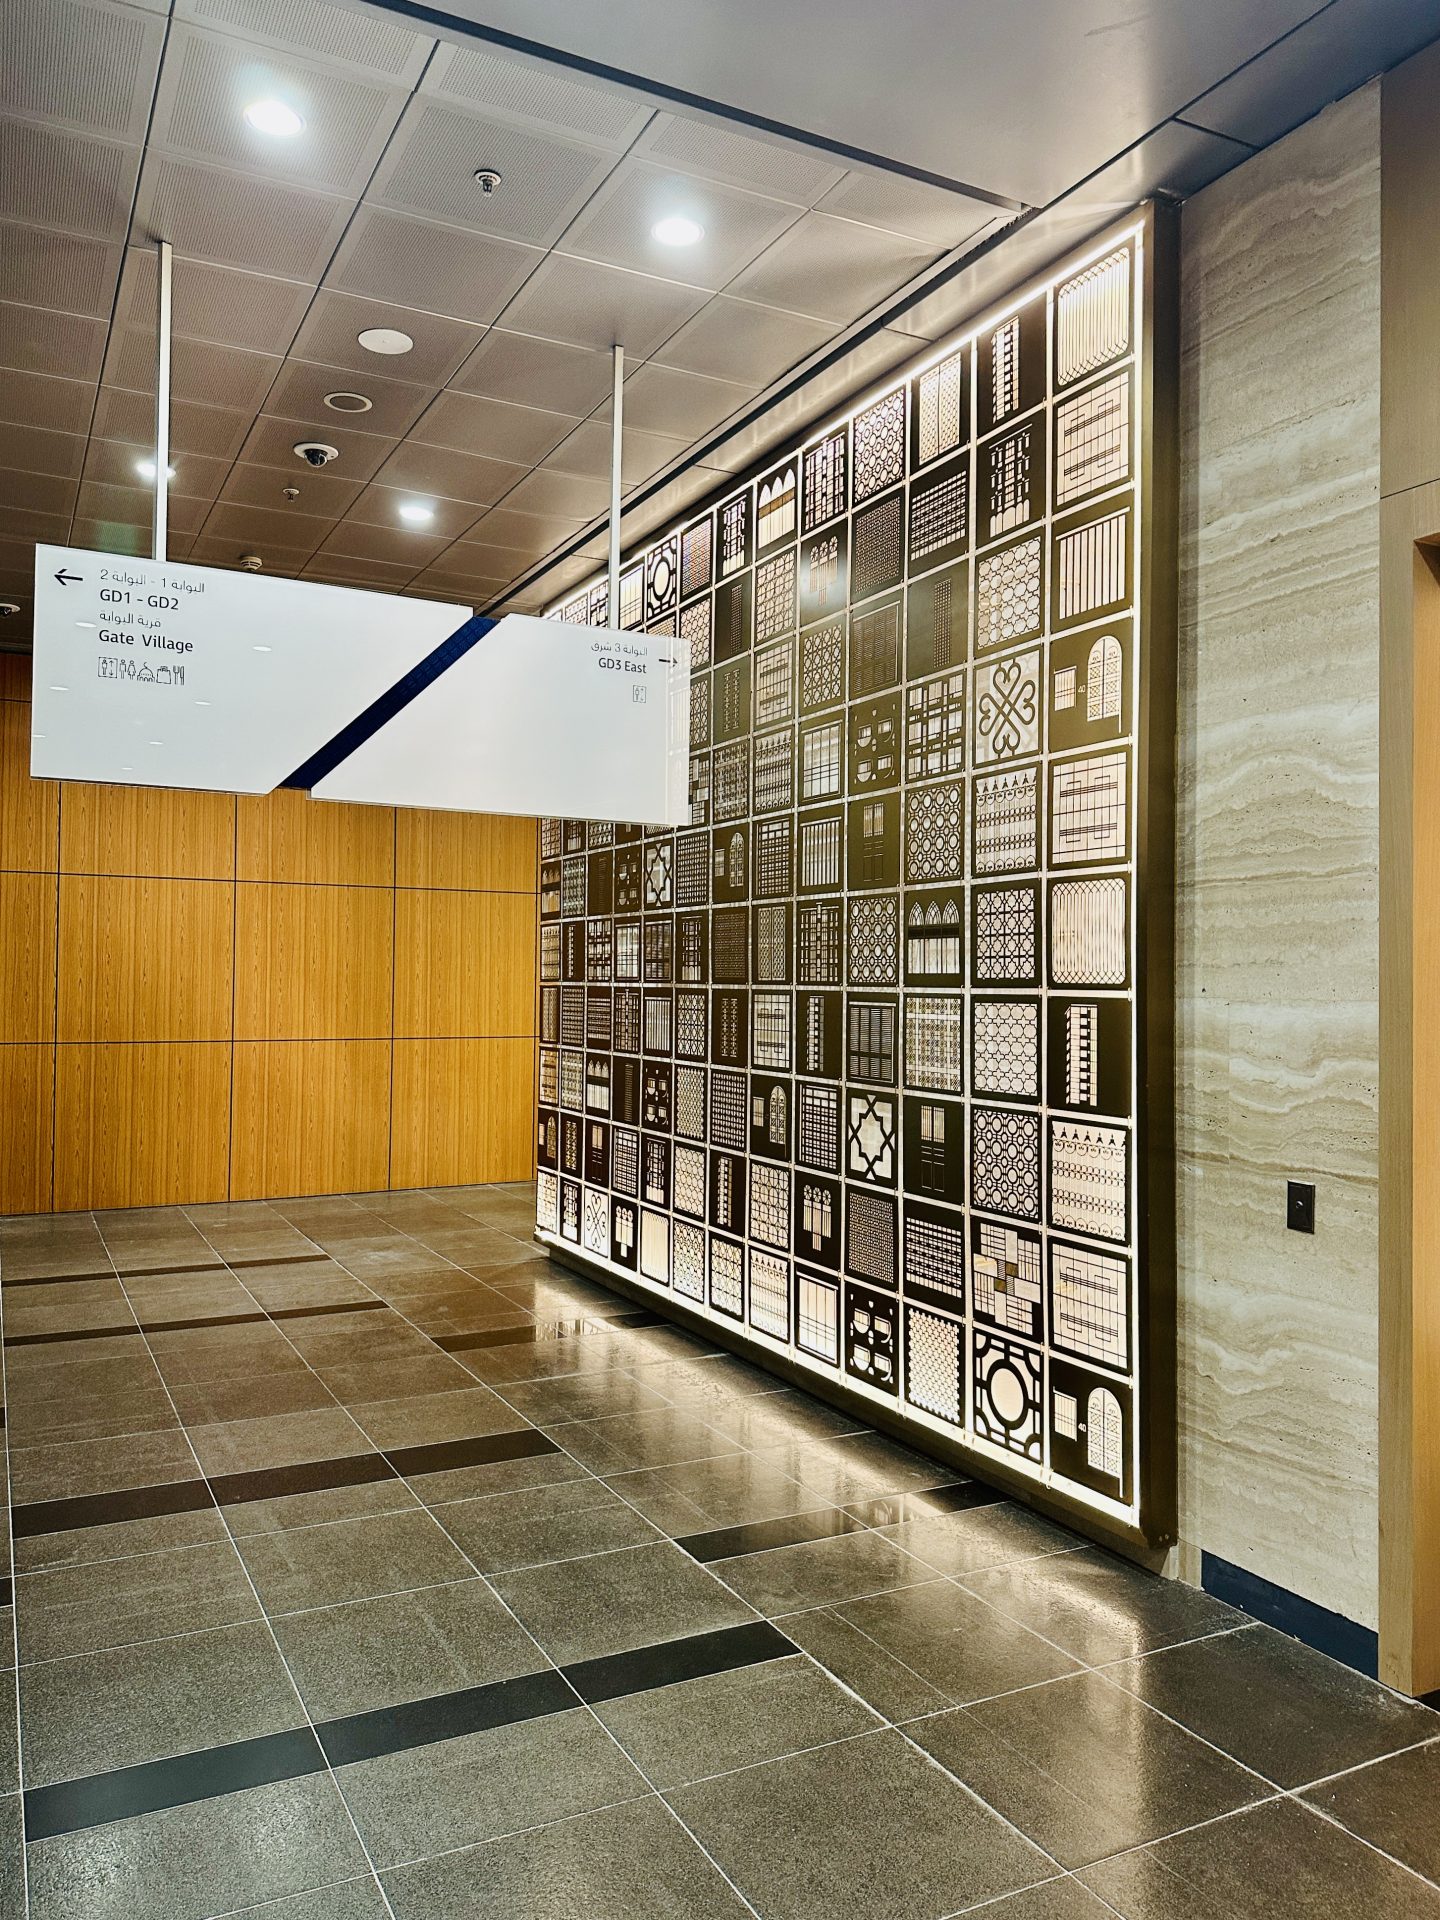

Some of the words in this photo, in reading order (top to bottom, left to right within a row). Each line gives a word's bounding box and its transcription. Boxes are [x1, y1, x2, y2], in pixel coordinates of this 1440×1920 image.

[100, 569, 109, 580] 2
[162, 577, 166, 588] 1
[100, 589, 130, 604] GD1
[148, 595, 179, 610] GD2
[99, 630, 134, 645] Gate
[142, 634, 193, 653] Village
[615, 643, 620, 652] 3
[599, 658, 621, 670] GD3
[625, 661, 646, 673] East
[1078, 1423, 1086, 1432] 40
